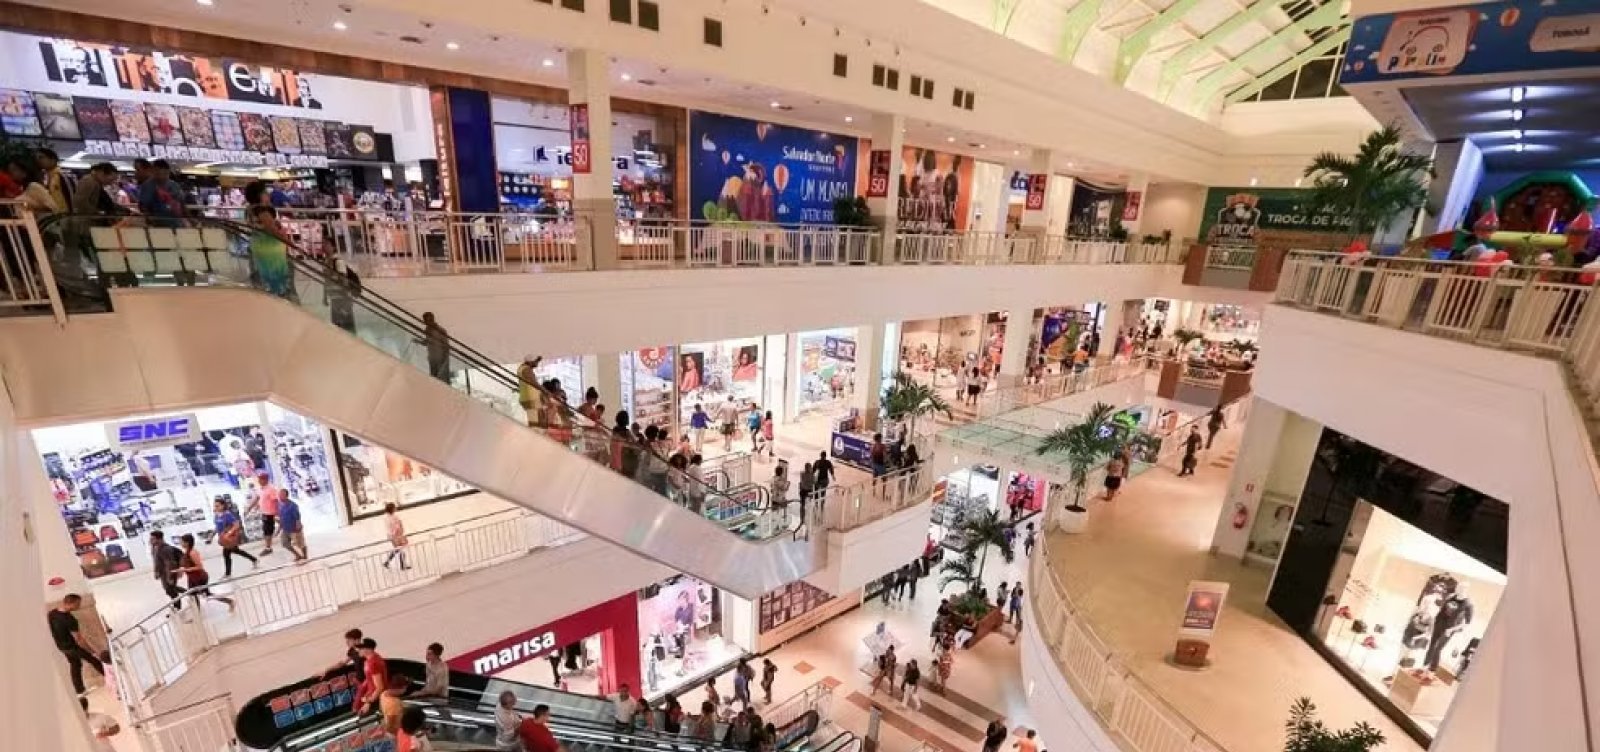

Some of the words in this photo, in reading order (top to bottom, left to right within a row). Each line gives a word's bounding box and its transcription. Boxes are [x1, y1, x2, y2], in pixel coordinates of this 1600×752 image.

[573, 142, 588, 166] 50
[871, 178, 886, 193] 50
[1028, 195, 1041, 207] 50
[119, 418, 189, 443] SNC
[473, 631, 556, 675] marisa
